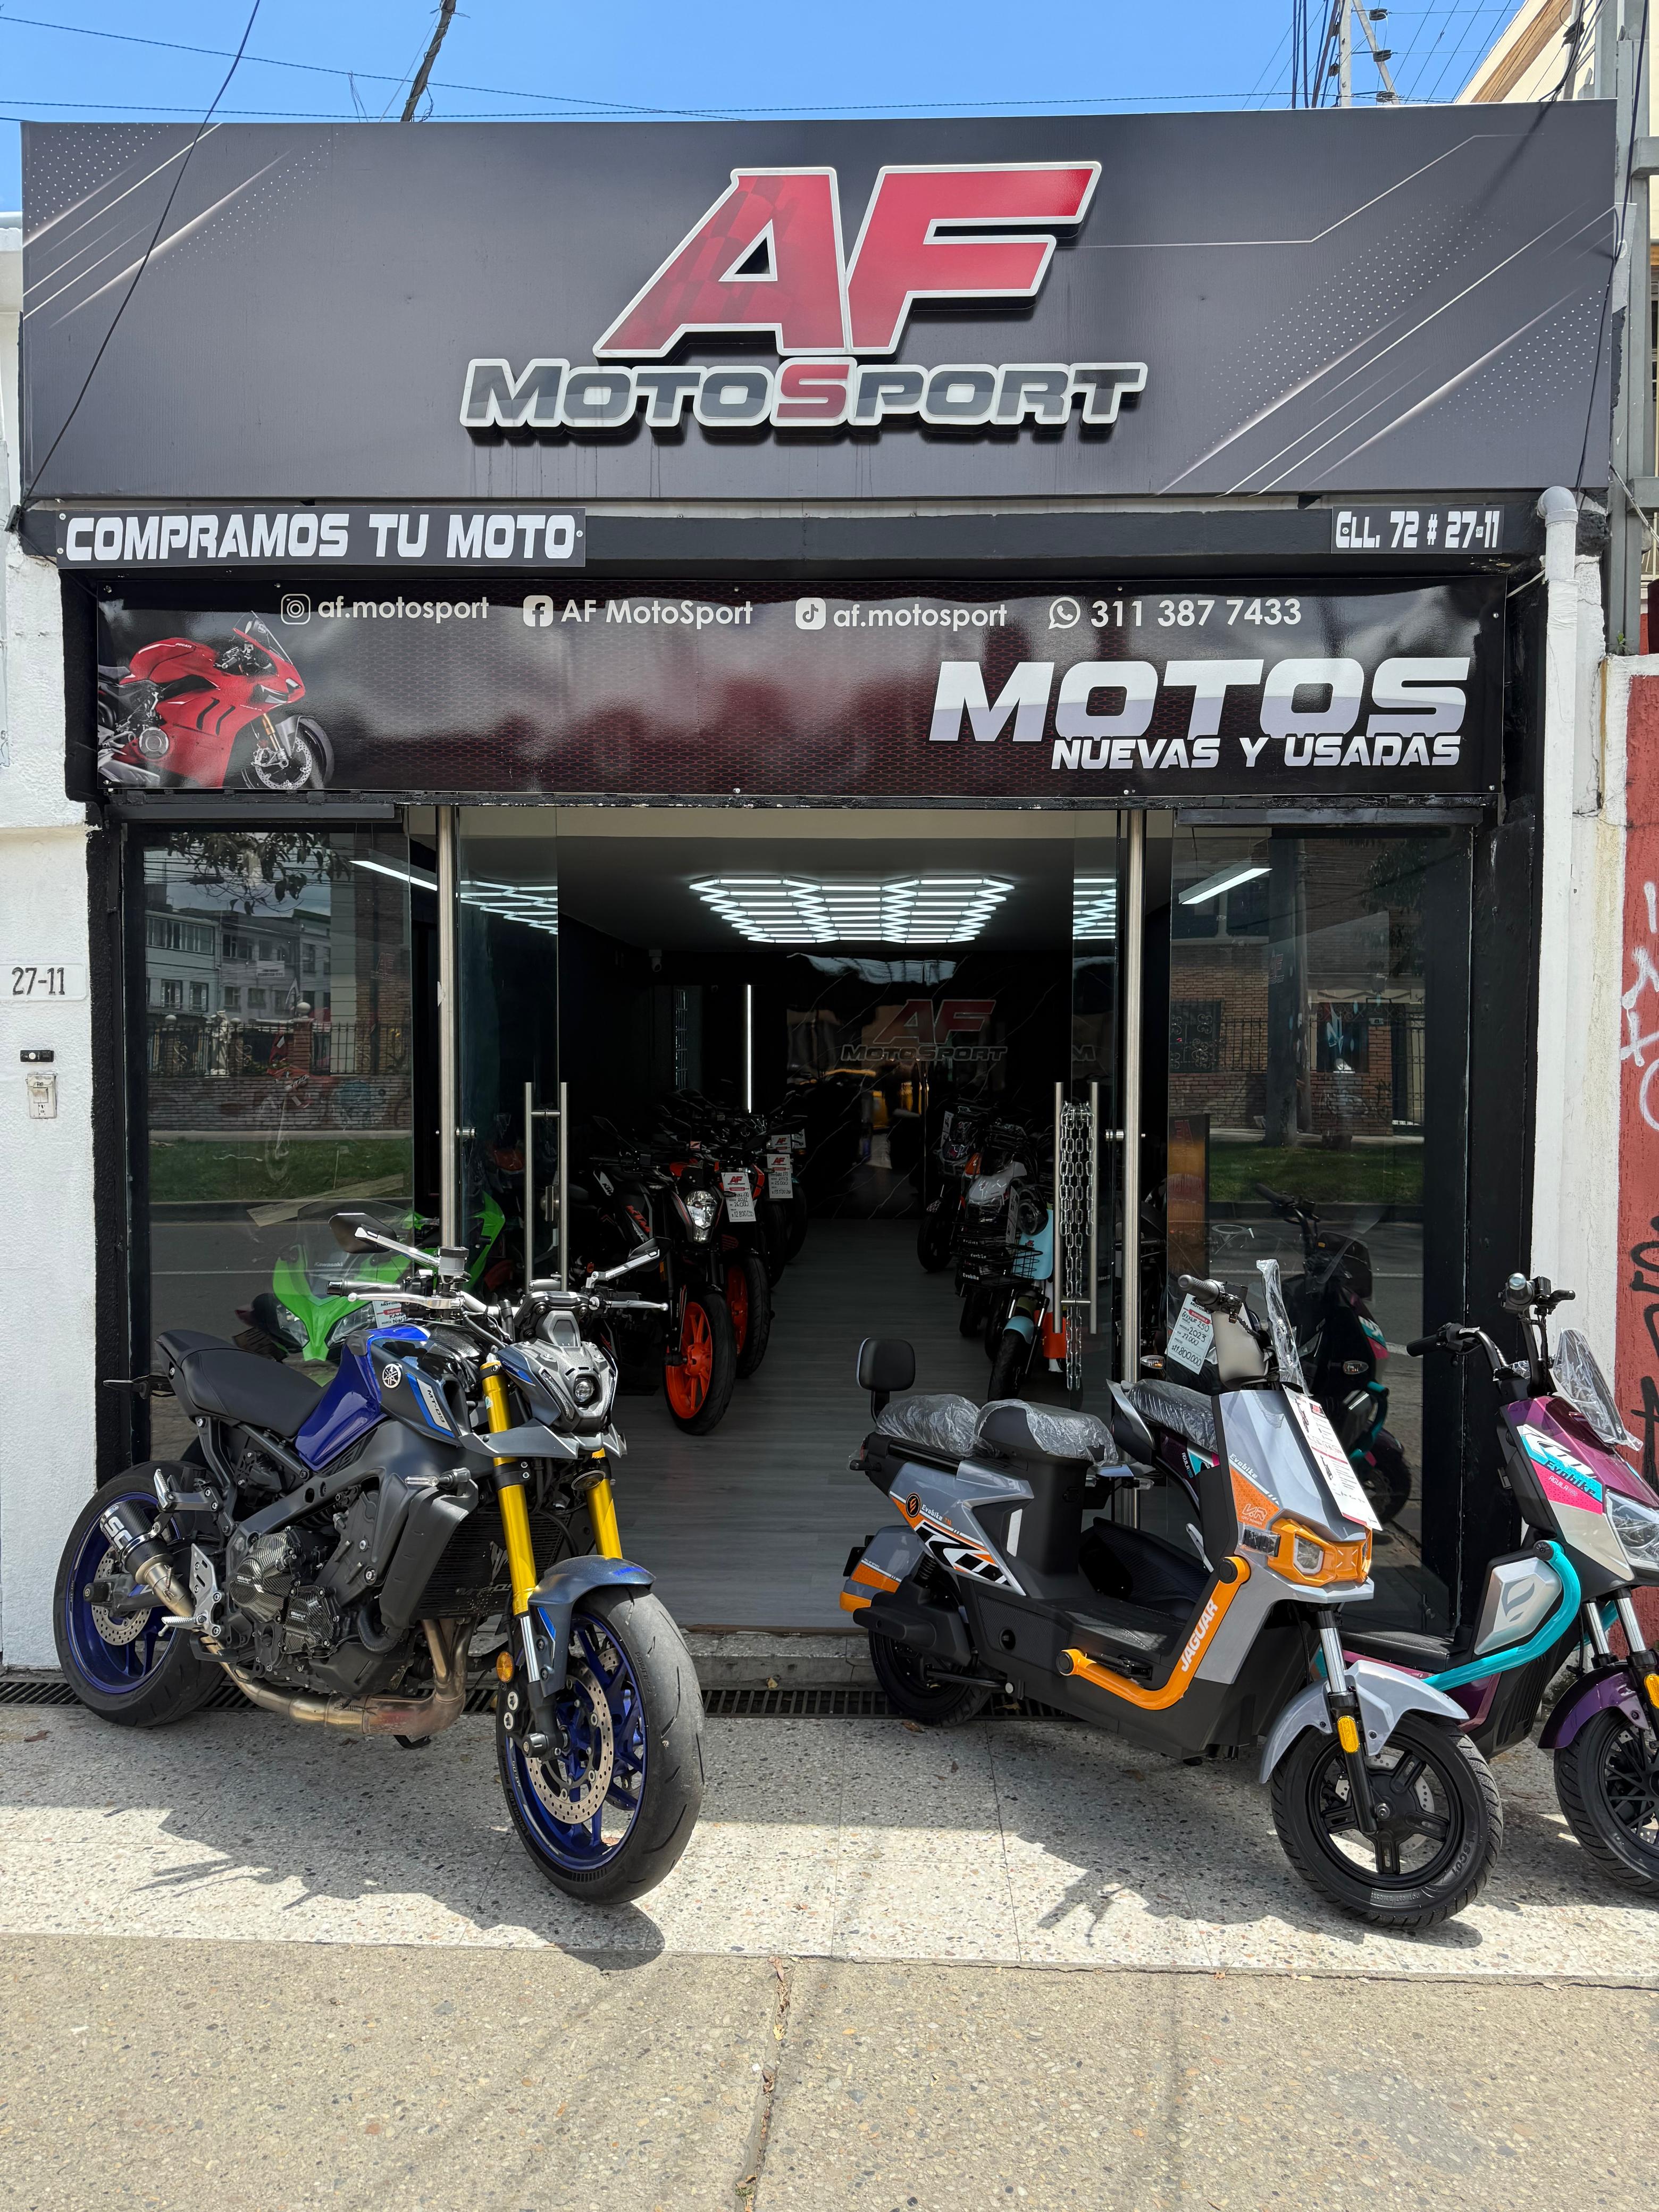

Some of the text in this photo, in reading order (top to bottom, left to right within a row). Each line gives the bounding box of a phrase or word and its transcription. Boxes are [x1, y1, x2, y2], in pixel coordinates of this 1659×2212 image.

[593, 161, 1102, 358] AF
[66, 514, 576, 562] COMPRAMOS TU MOTO
[1390, 511, 1419, 548] 72
[1445, 510, 1500, 548] 27-11
[318, 596, 489, 624] af.motosport
[561, 599, 753, 629] AF MotoSport
[834, 602, 1007, 632] af.motosport
[1091, 598, 1302, 627] 311 387 7433
[928, 657, 1470, 742] MOTOS
[1051, 735, 1460, 769] NUEVAS Y USADAS
[11, 966, 65, 995] 27-11
[873, 999, 996, 1044] AF
[1188, 1327, 1206, 1342] 2023
[1197, 1321, 1210, 1332] 250
[1229, 1453, 1258, 1479] Evobike
[1544, 1460, 1596, 1497] Evobike
[1548, 1476, 1569, 1491] AGUILA
[921, 1504, 943, 1521] Evobike
[1180, 1599, 1219, 1672] JAGUAR
